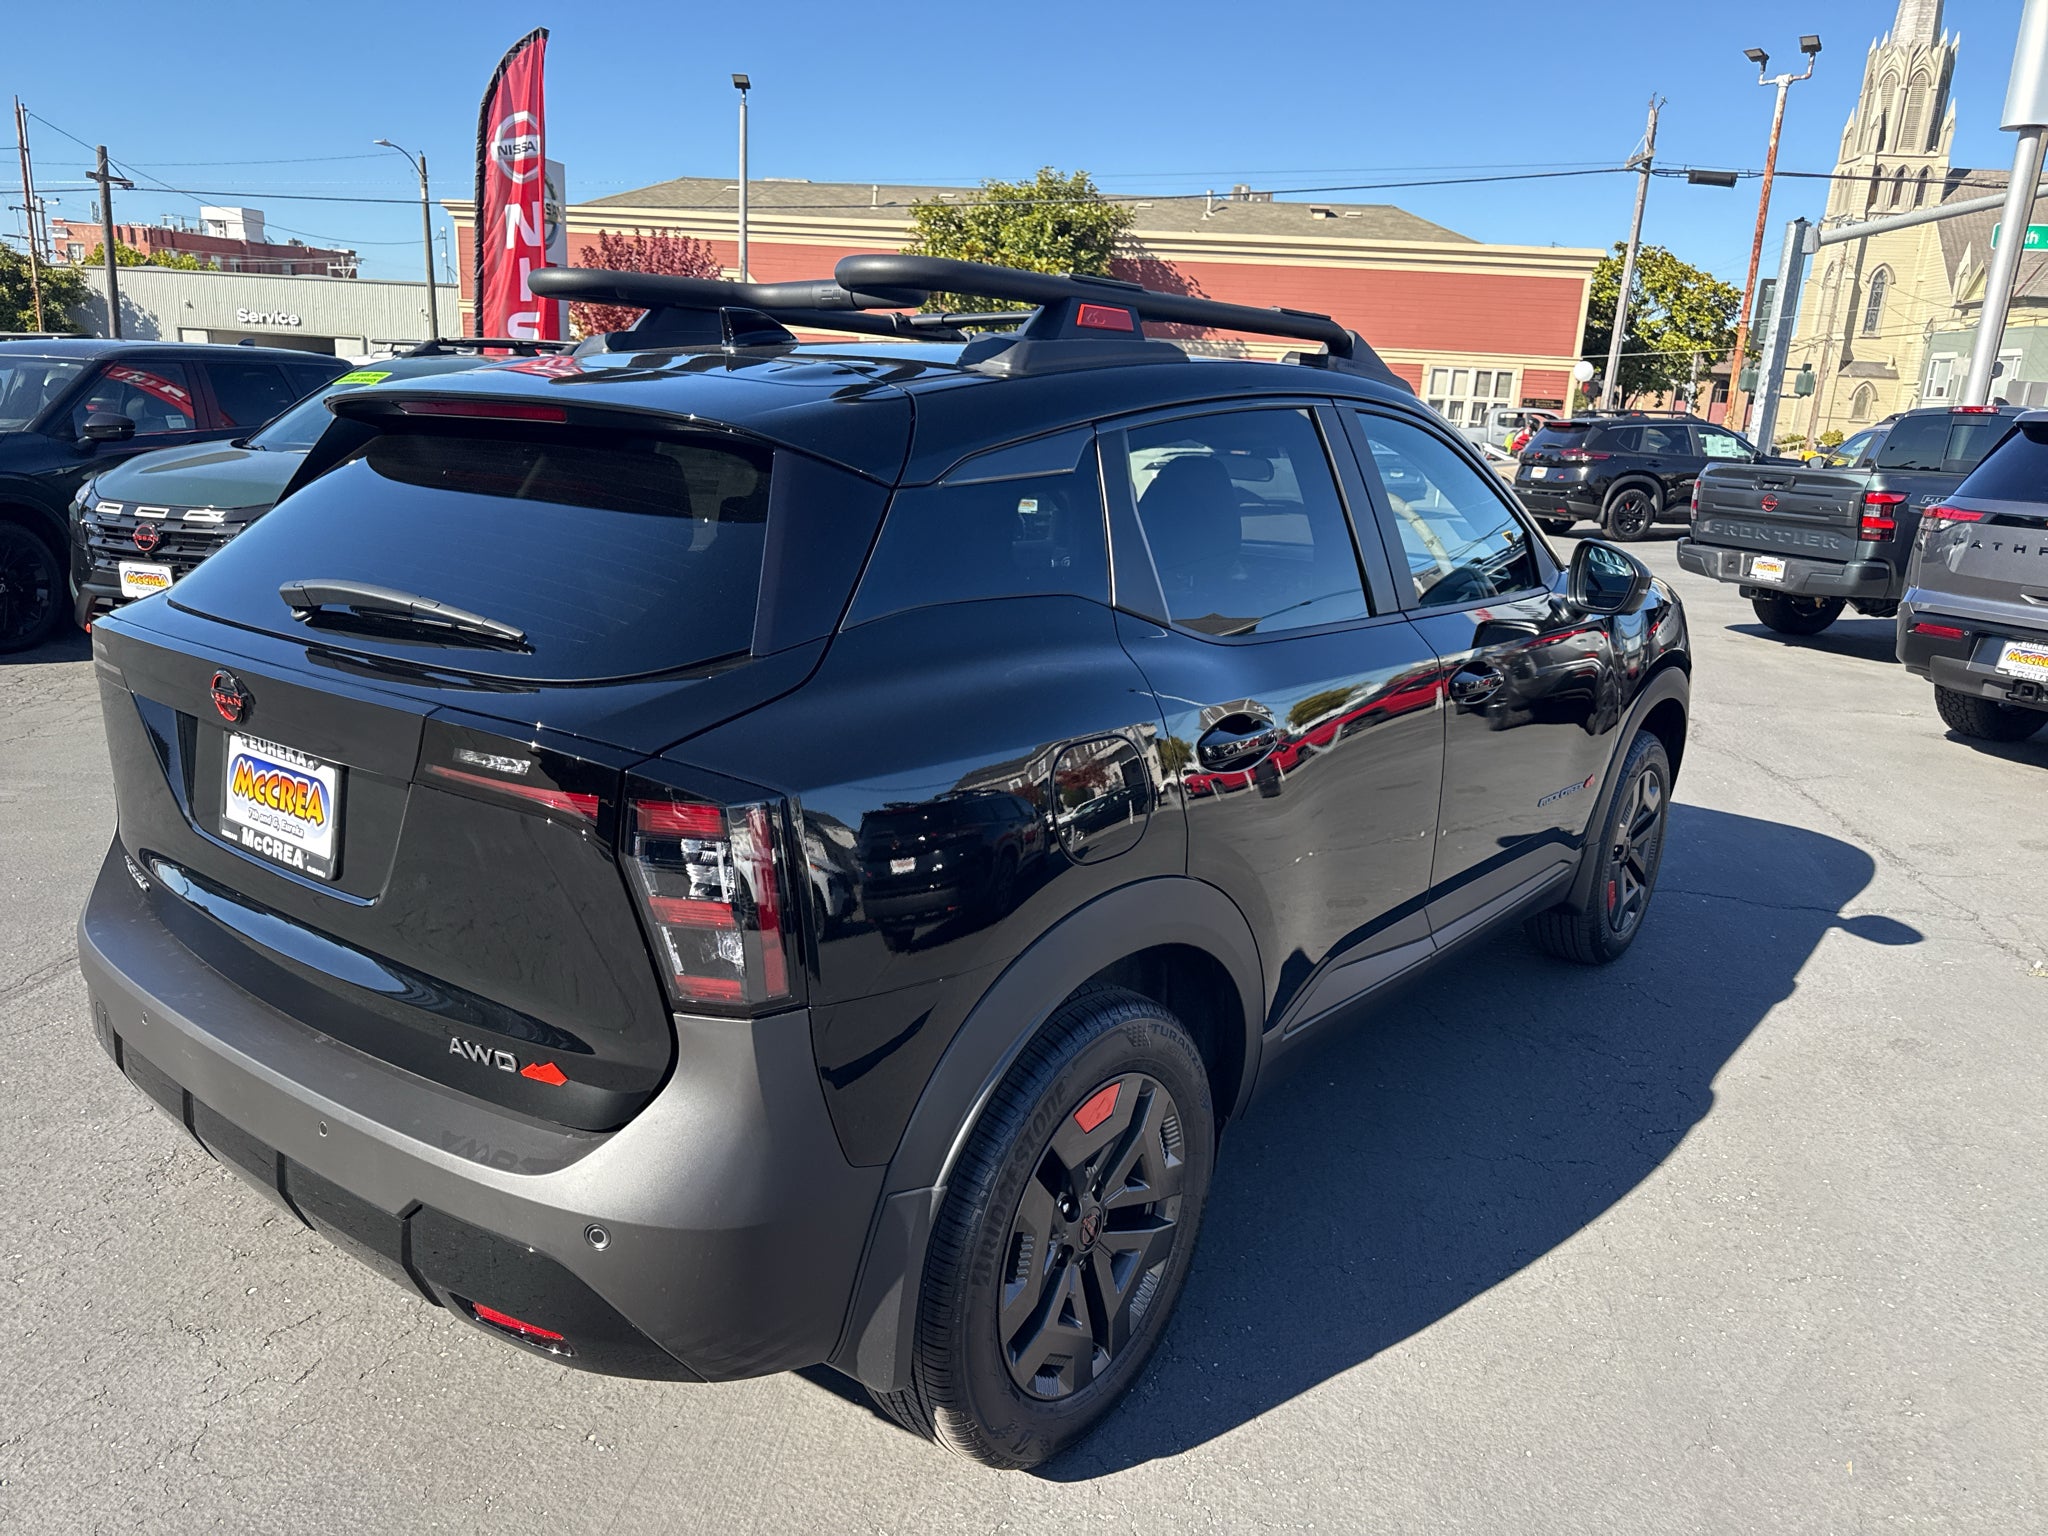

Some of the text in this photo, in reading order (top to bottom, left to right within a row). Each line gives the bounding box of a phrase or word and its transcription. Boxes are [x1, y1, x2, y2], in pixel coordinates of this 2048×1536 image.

[237, 308, 301, 326] Service
[1704, 521, 1840, 550] FRONTIER
[233, 762, 325, 826] McCREA
[260, 814, 272, 826] and
[281, 819, 305, 839] Eureka
[241, 826, 304, 869] McCREA
[449, 1036, 519, 1073] AWD
[1151, 1022, 1205, 1079] TURANZA
